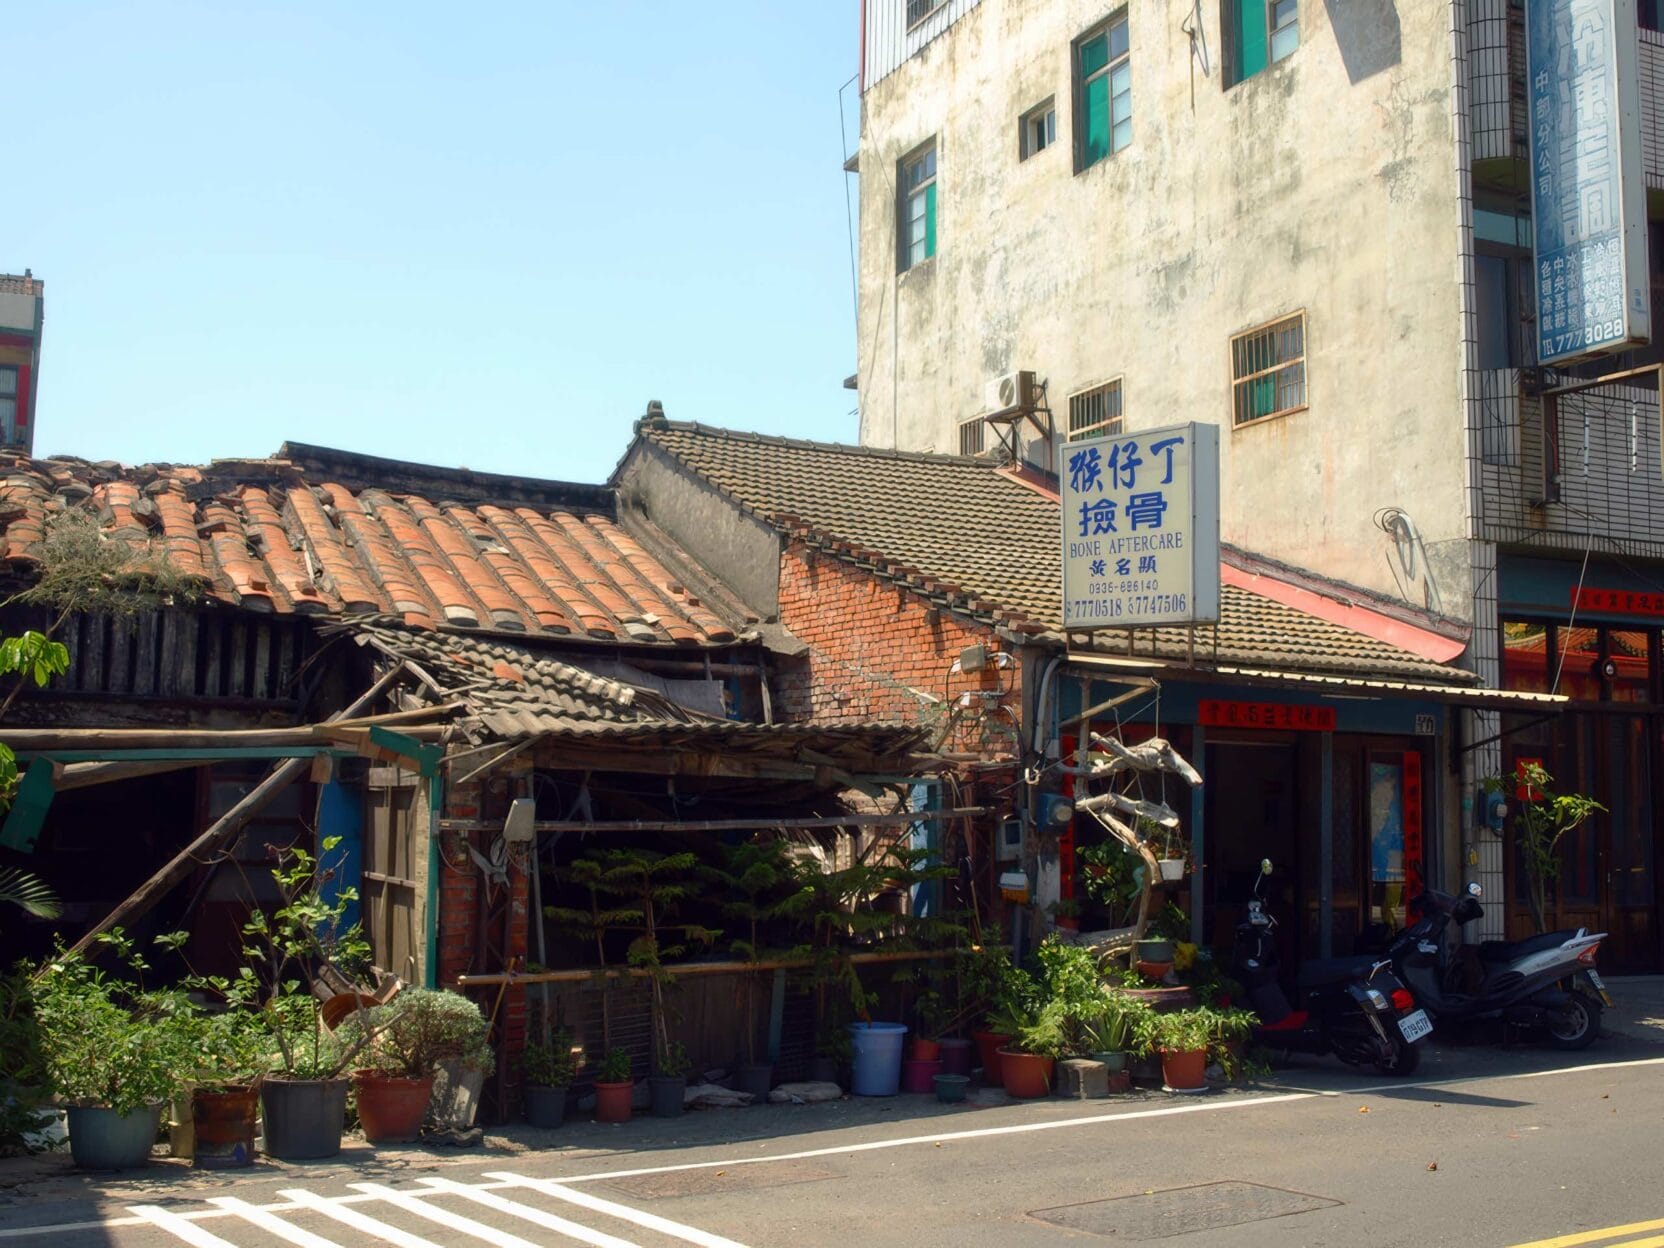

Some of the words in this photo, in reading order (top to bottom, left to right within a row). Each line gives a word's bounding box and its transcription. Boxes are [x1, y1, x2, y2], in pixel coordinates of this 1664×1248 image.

[1535, 69, 1552, 196] 中部分公司
[1069, 436, 1185, 493] 猴仔丁
[1078, 491, 1168, 537] 撿骨
[1070, 540, 1101, 559] BONE
[1109, 532, 1183, 554] AFTERCARE
[1075, 598, 1122, 618] 7770518
[1136, 594, 1186, 615] 7747506
